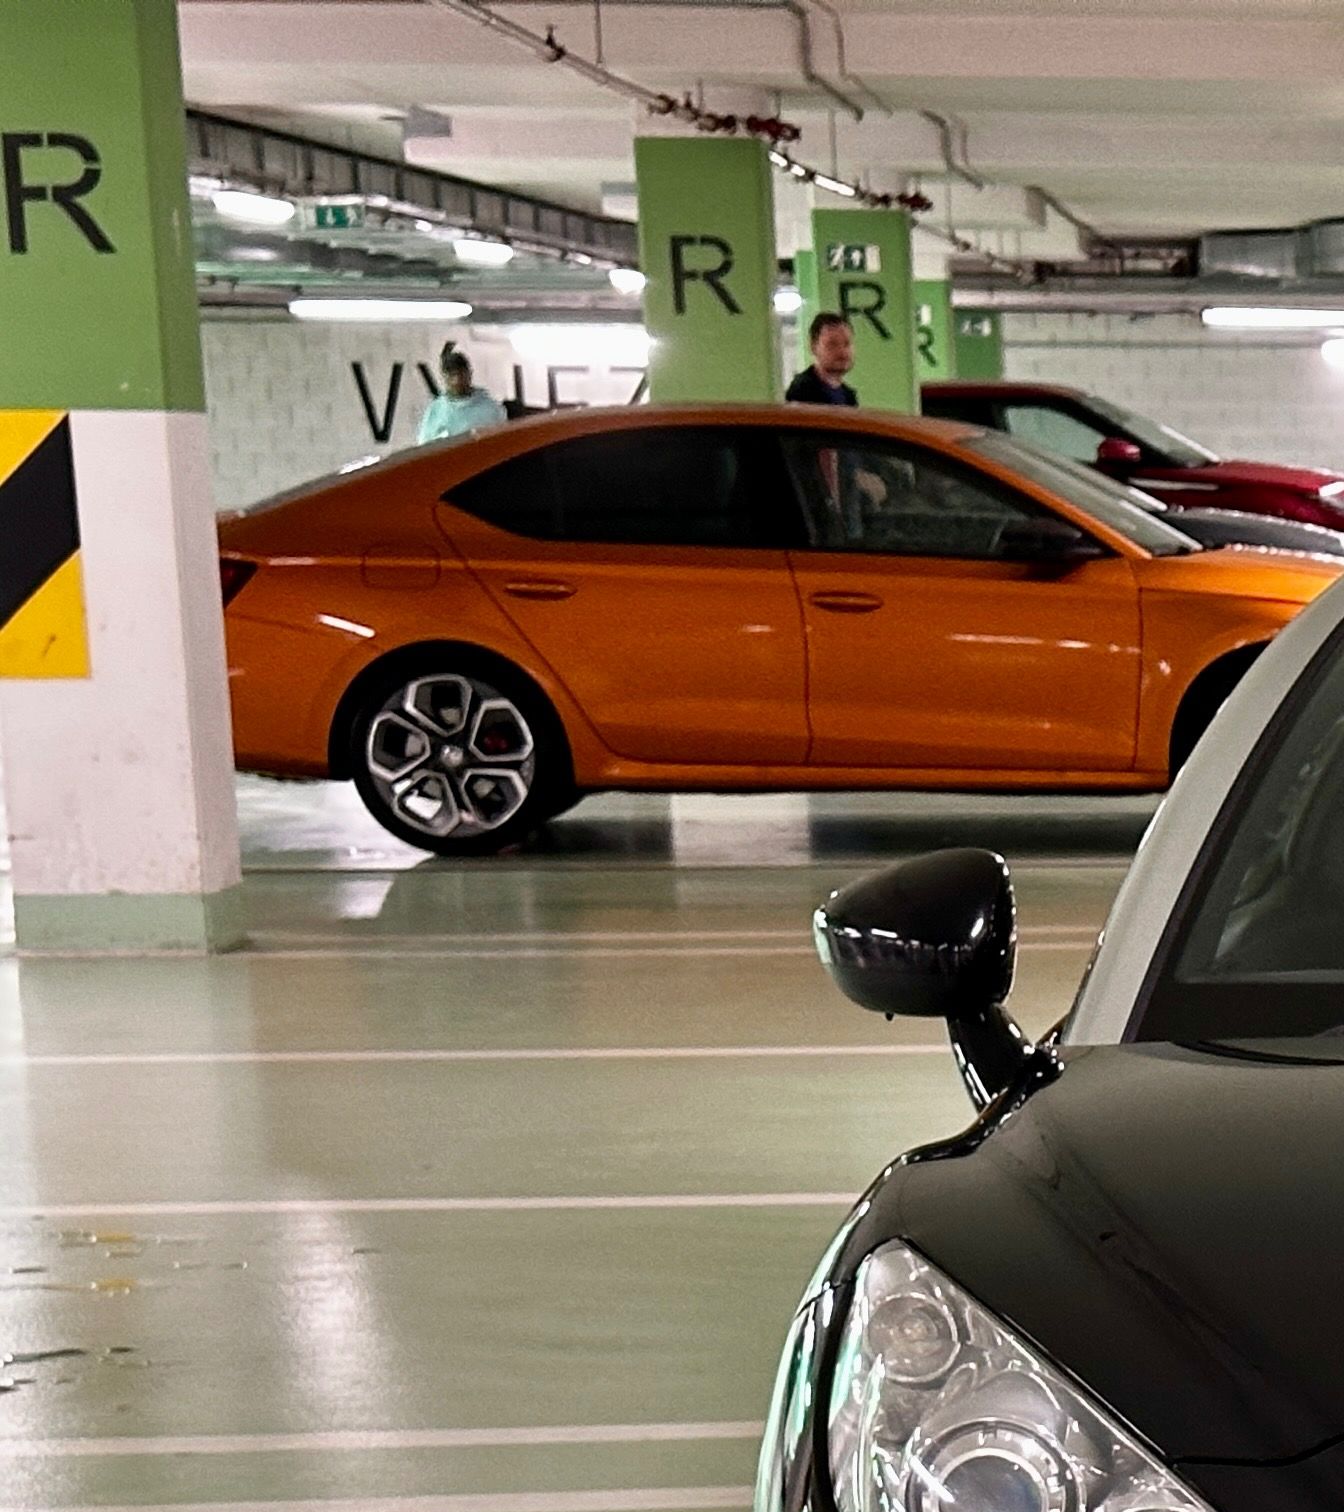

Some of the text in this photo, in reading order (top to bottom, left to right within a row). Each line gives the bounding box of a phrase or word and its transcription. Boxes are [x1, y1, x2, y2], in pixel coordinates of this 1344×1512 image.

[2, 132, 117, 255] R
[670, 235, 742, 316] R
[839, 280, 891, 340] R
